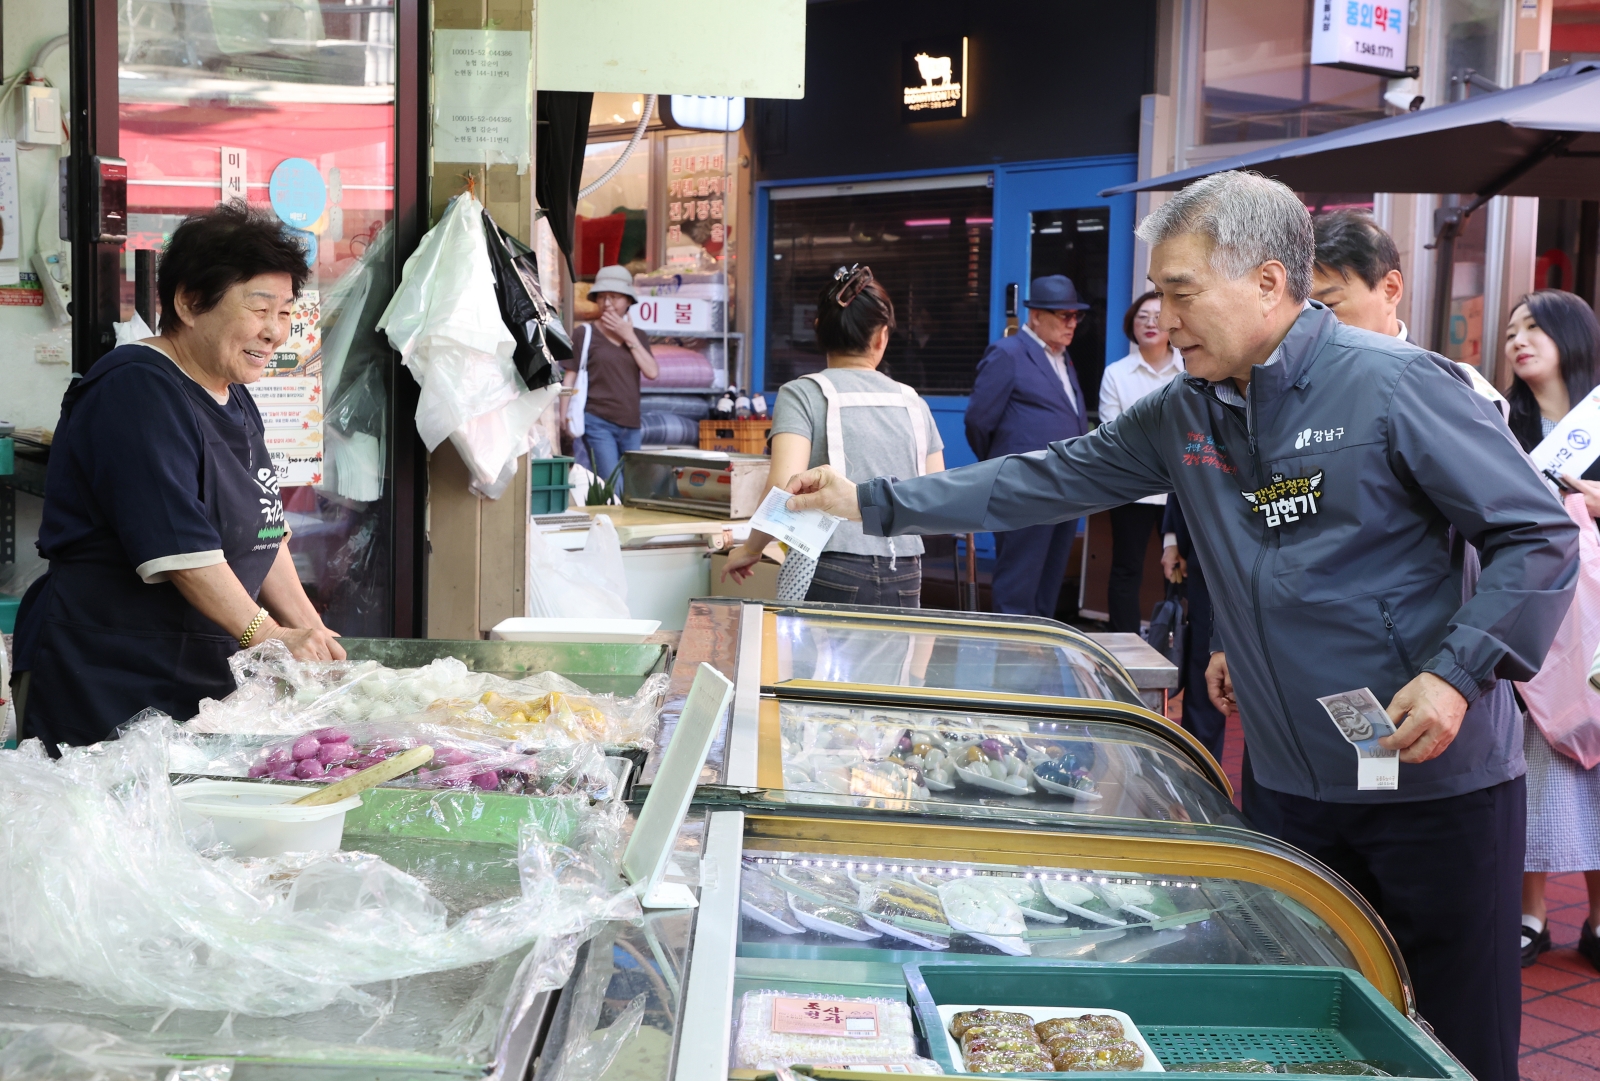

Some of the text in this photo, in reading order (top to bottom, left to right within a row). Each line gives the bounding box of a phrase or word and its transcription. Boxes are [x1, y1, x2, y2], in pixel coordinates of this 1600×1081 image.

[1347, 1, 1402, 34] 중외약국
[452, 49, 512, 57] 100015-52044386
[452, 115, 512, 123] 100015-52-044386
[669, 199, 724, 222] 전기장판
[1313, 427, 1345, 443] 강남구
[1254, 478, 1310, 503] 강남구청장
[1259, 493, 1318, 528] 김현기
